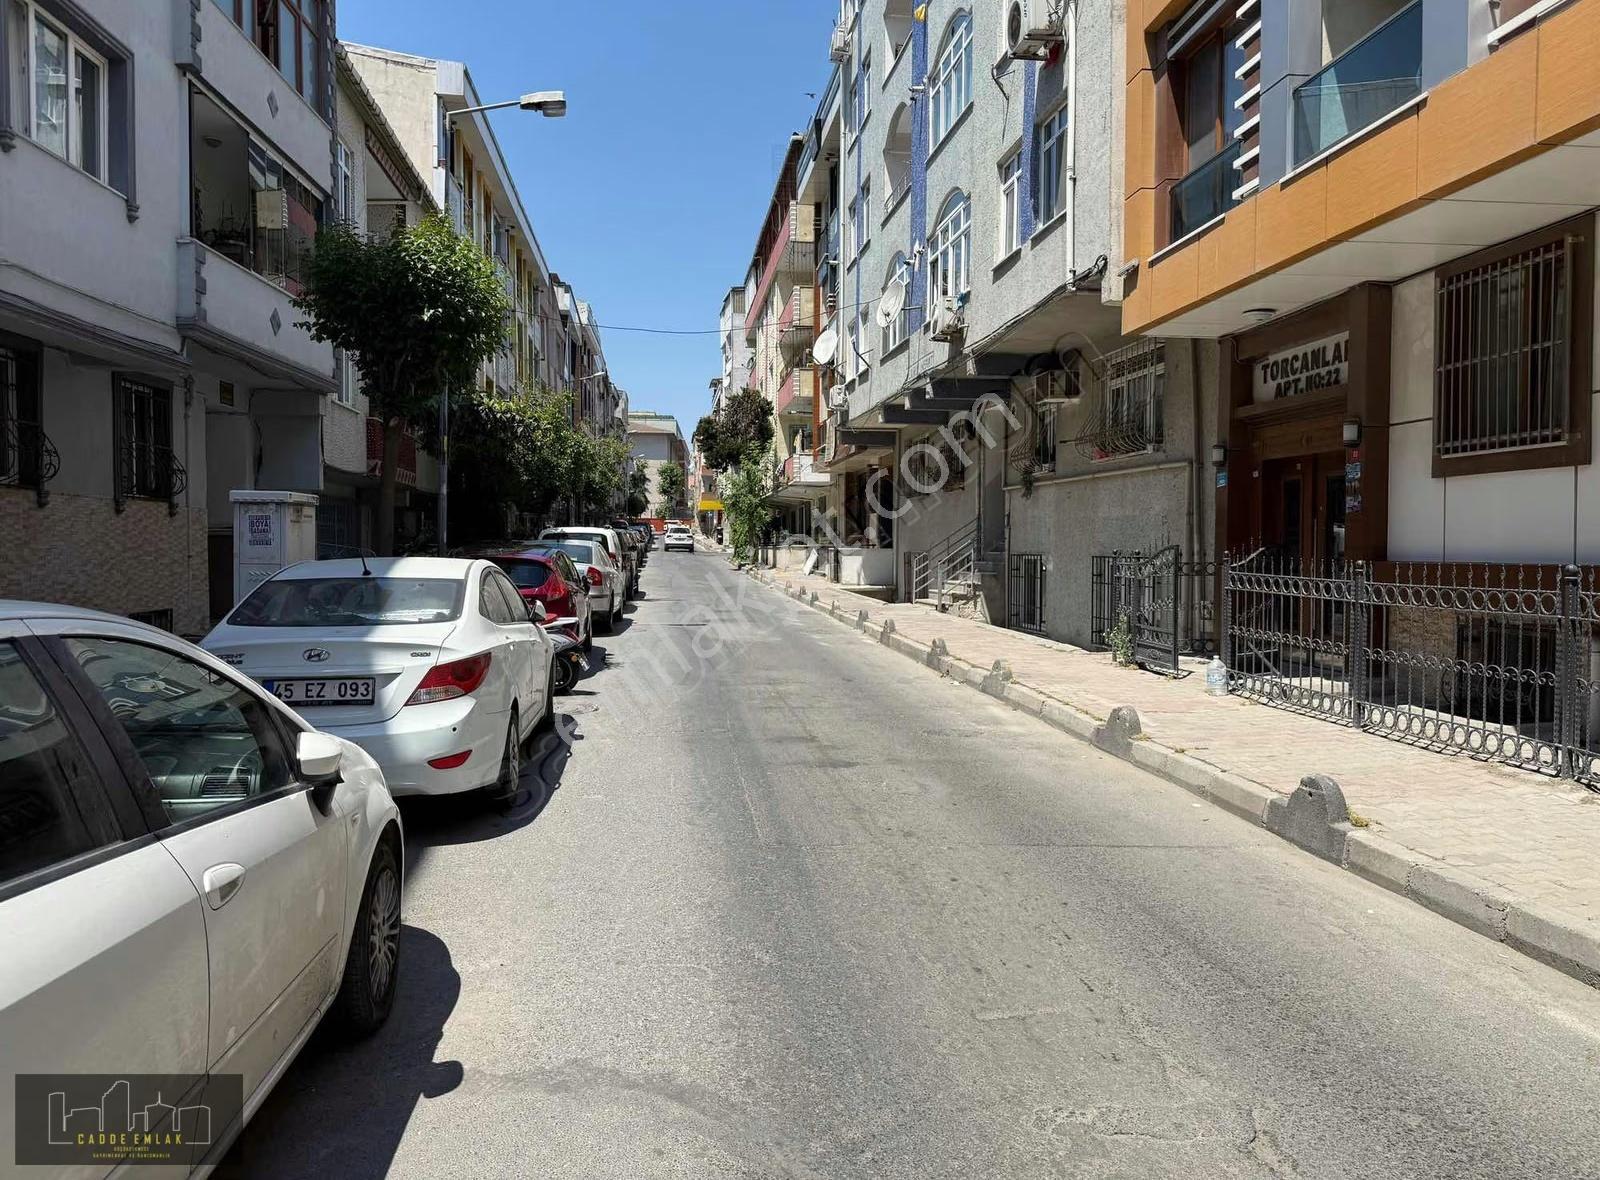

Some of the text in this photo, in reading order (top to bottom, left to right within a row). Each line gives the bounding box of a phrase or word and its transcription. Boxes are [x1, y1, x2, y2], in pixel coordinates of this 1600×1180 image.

[274, 681, 370, 699] 45 EZ 093
